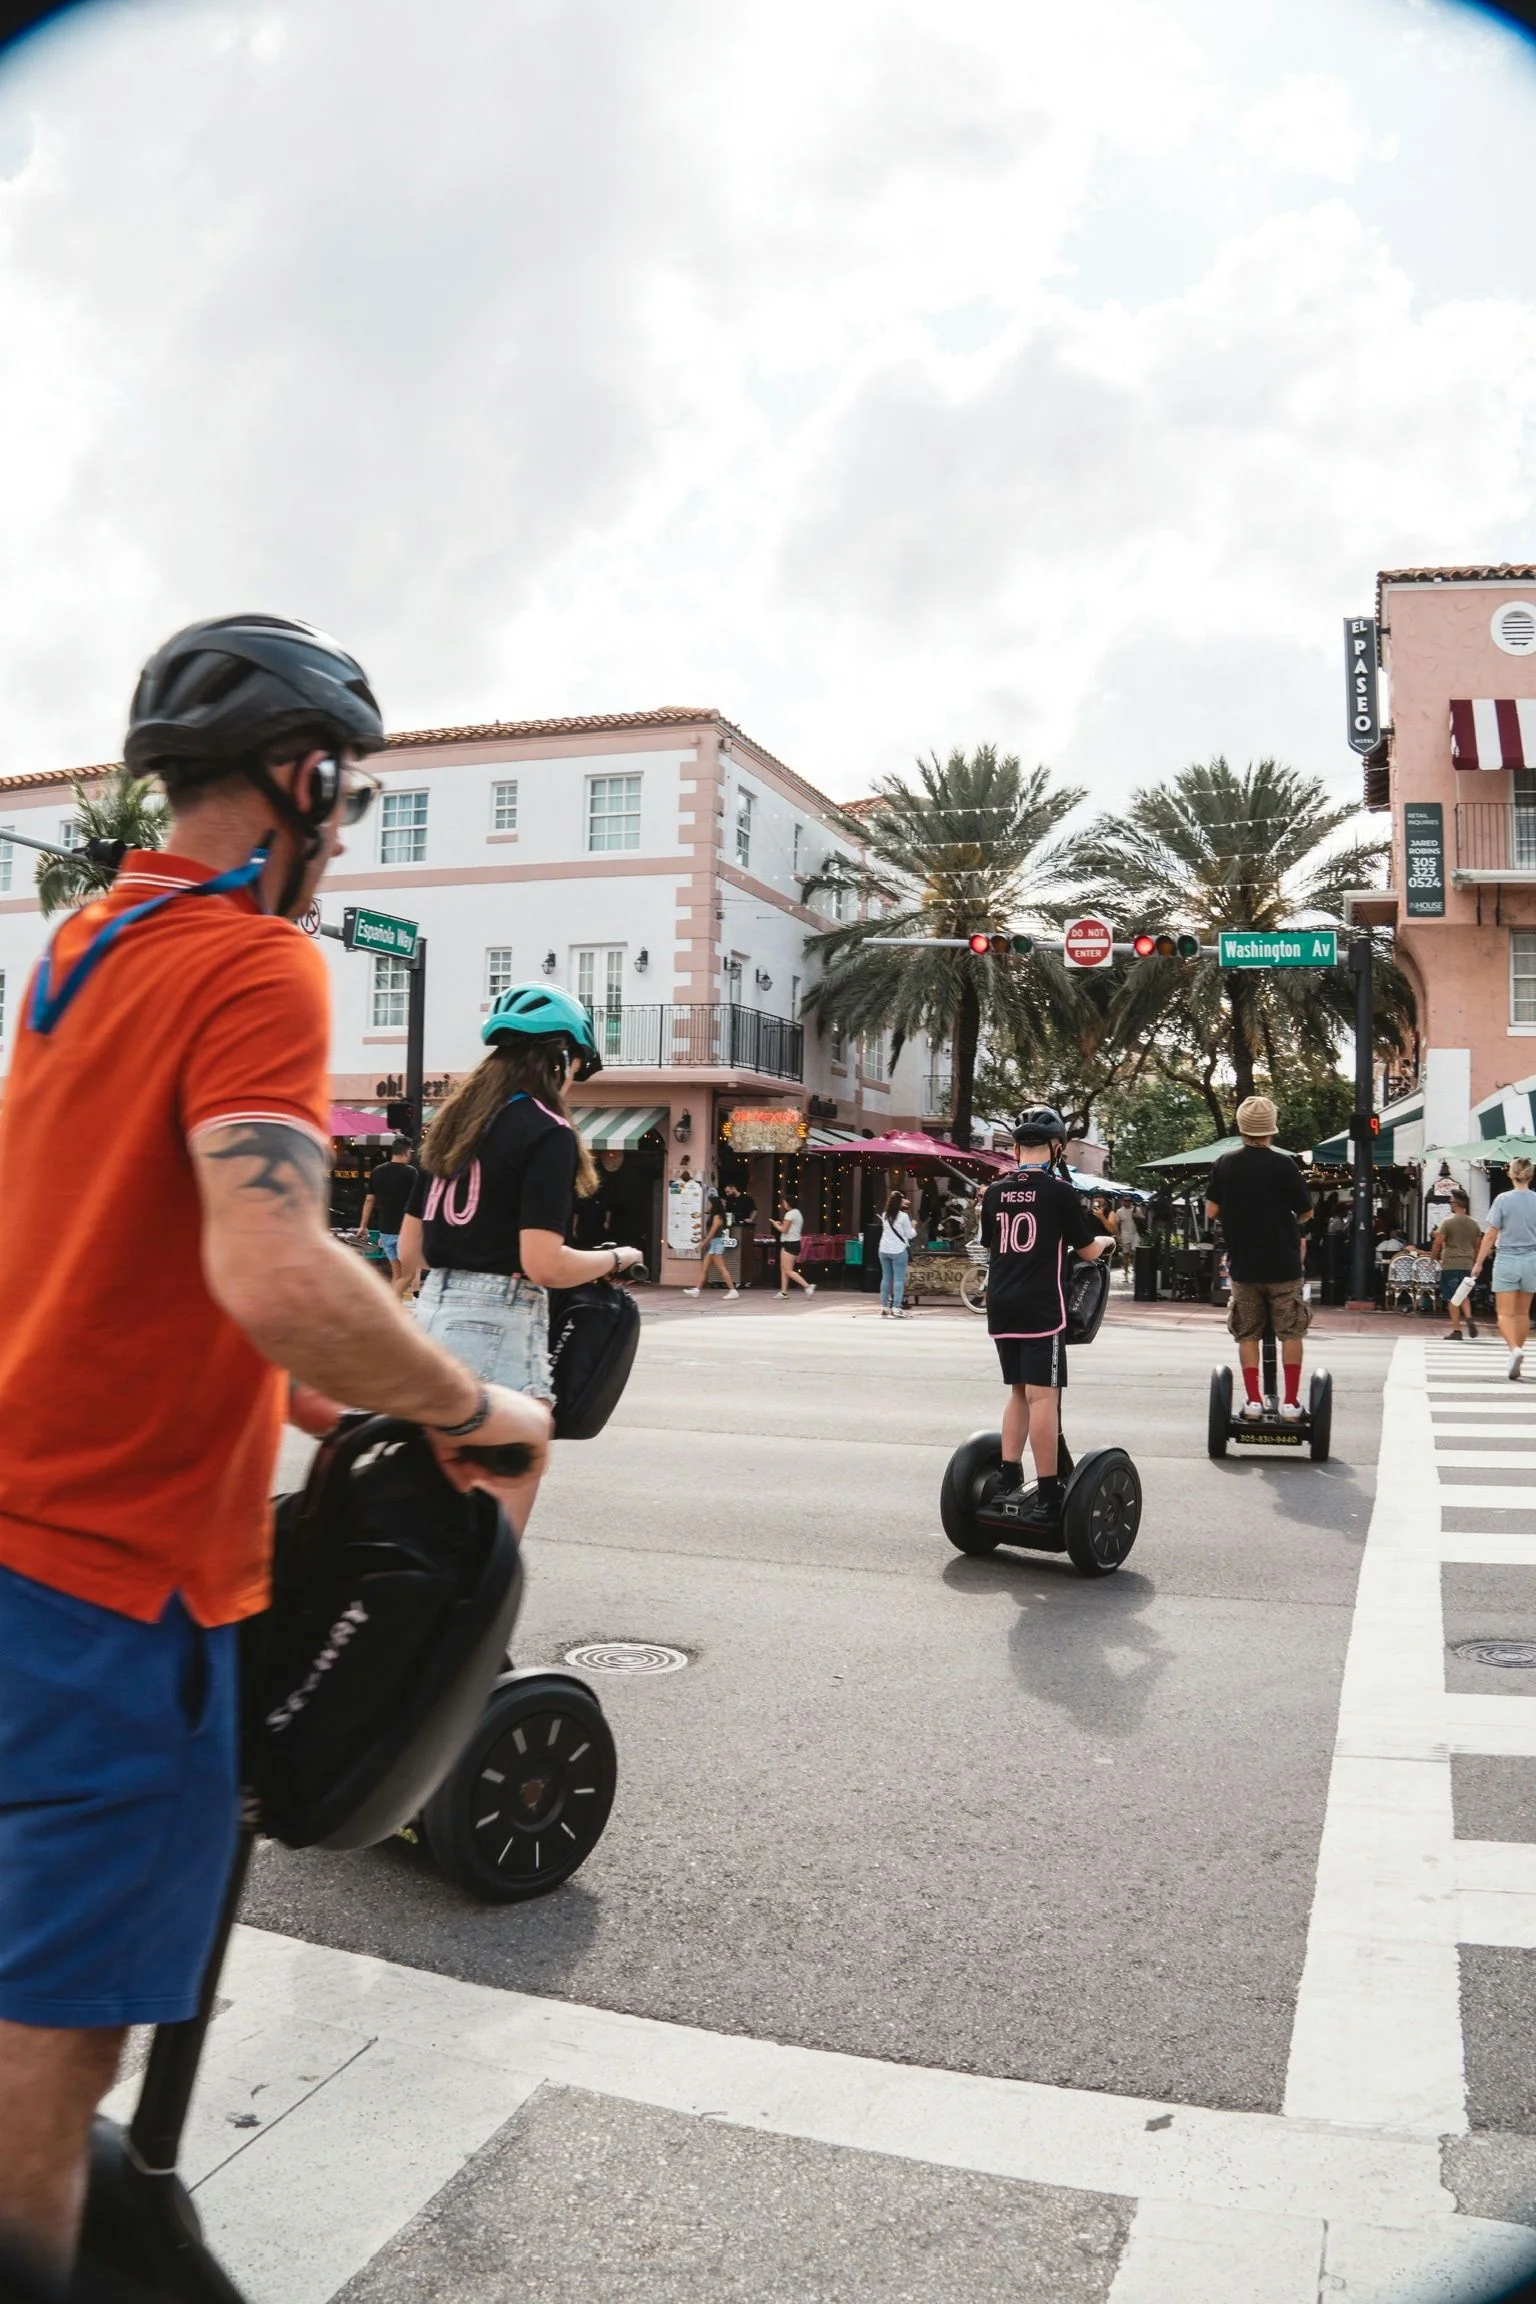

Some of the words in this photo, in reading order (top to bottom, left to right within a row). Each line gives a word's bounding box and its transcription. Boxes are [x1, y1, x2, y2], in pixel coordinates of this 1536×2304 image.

[1351, 620, 1368, 634] EL
[1353, 639, 1372, 732] PASEO
[1410, 839, 1439, 847] JARED
[1408, 847, 1441, 855] ROBINS
[1411, 857, 1437, 867] 305
[1412, 867, 1437, 877] 323
[1408, 877, 1442, 888] 0524
[357, 918, 395, 945] Española
[397, 928, 414, 953] Way
[1071, 928, 1084, 937] DO
[1088, 928, 1105, 937] NOT
[1074, 949, 1102, 958] ENTER
[1224, 939, 1301, 963] Washington
[1312, 939, 1331, 957] Av
[1370, 1118, 1379, 1136] 9
[1000, 1190, 1037, 1203] MESSI
[996, 1211, 1037, 1254] 10
